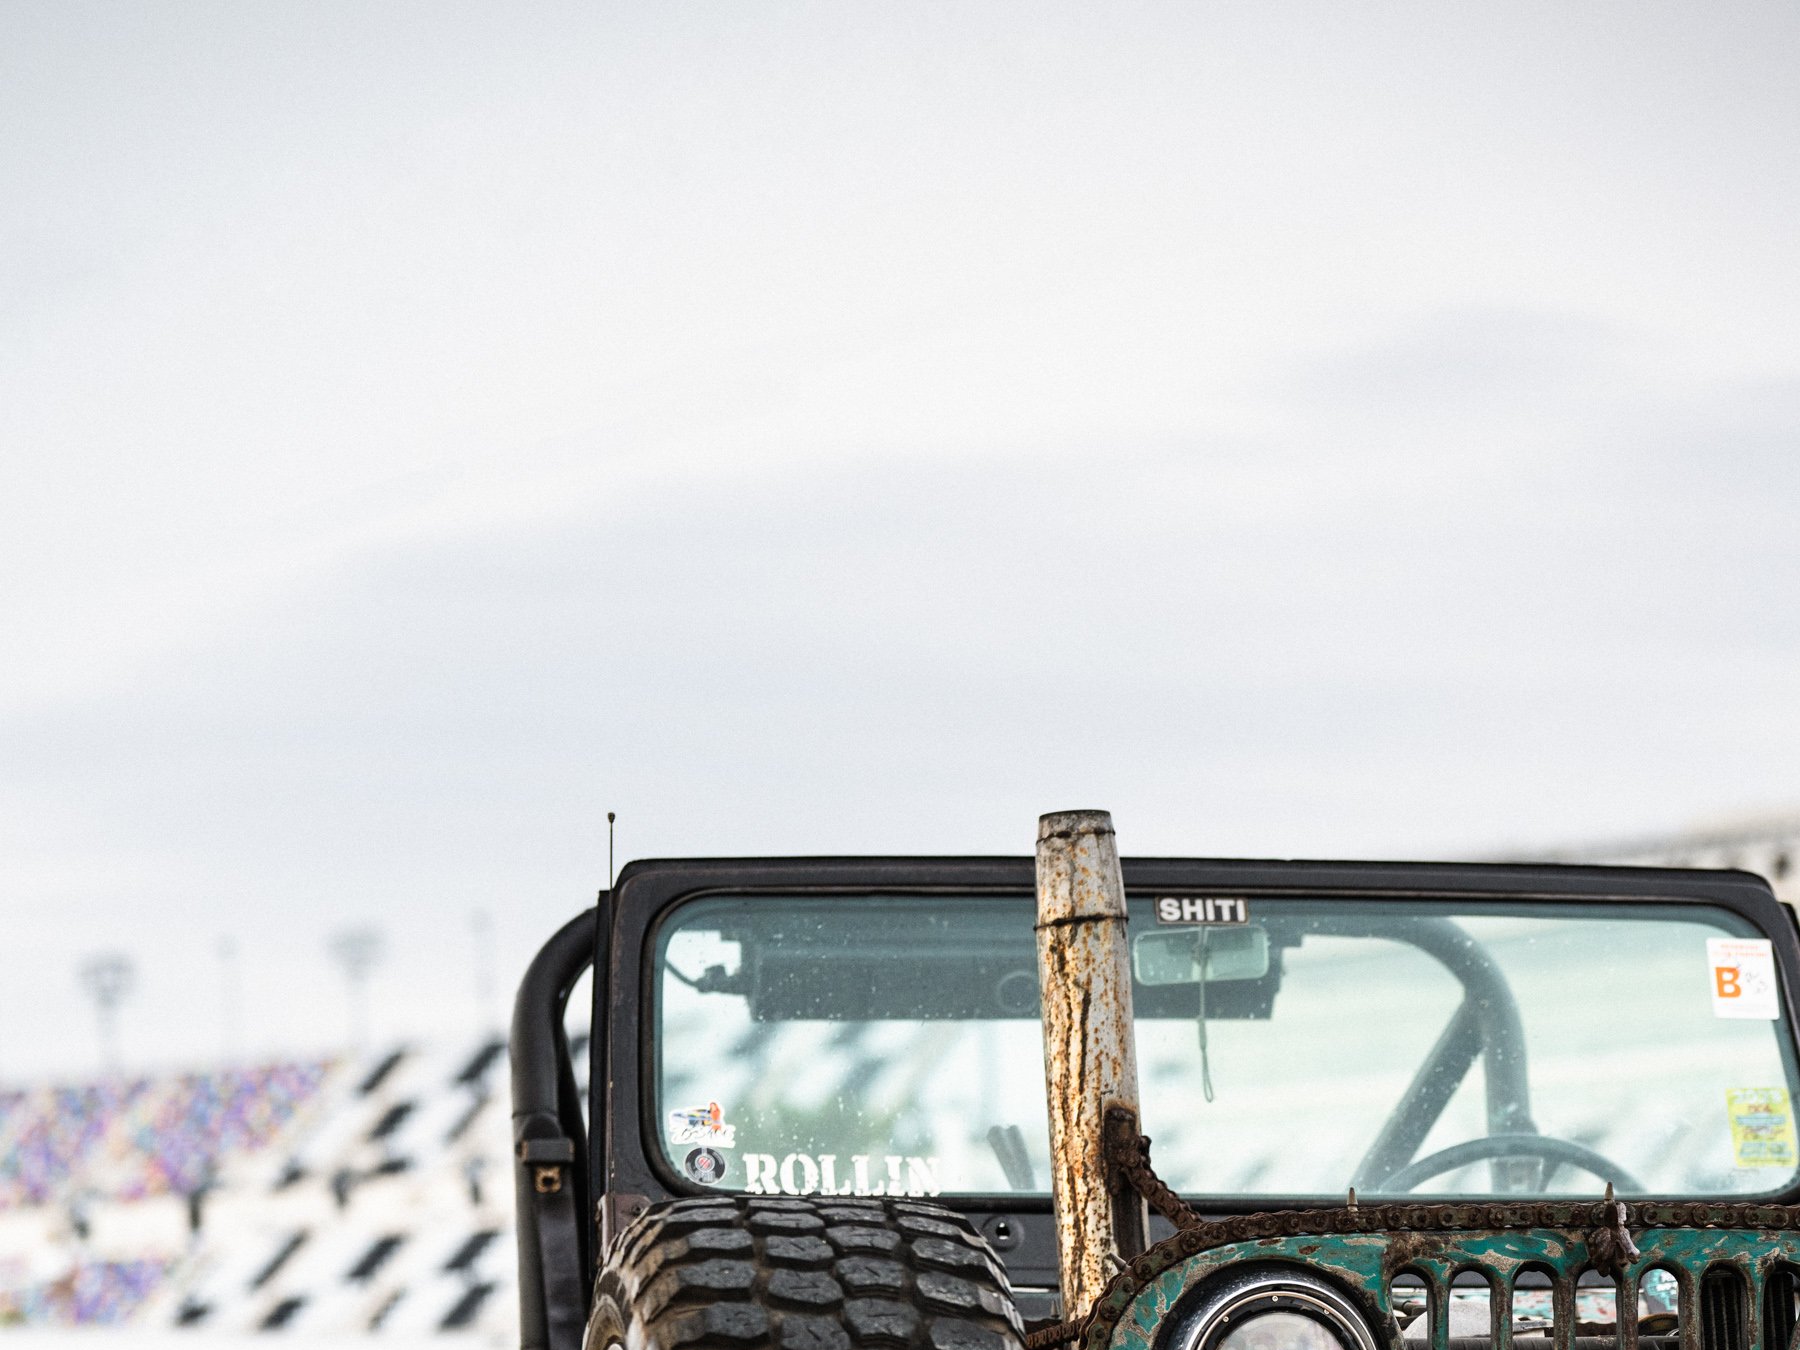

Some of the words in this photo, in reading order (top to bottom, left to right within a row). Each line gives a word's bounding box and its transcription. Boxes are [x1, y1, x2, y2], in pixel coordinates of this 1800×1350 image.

[1159, 898, 1246, 921] SHITI
[1715, 966, 1742, 998] B
[742, 1153, 941, 1197] ROLLIN
